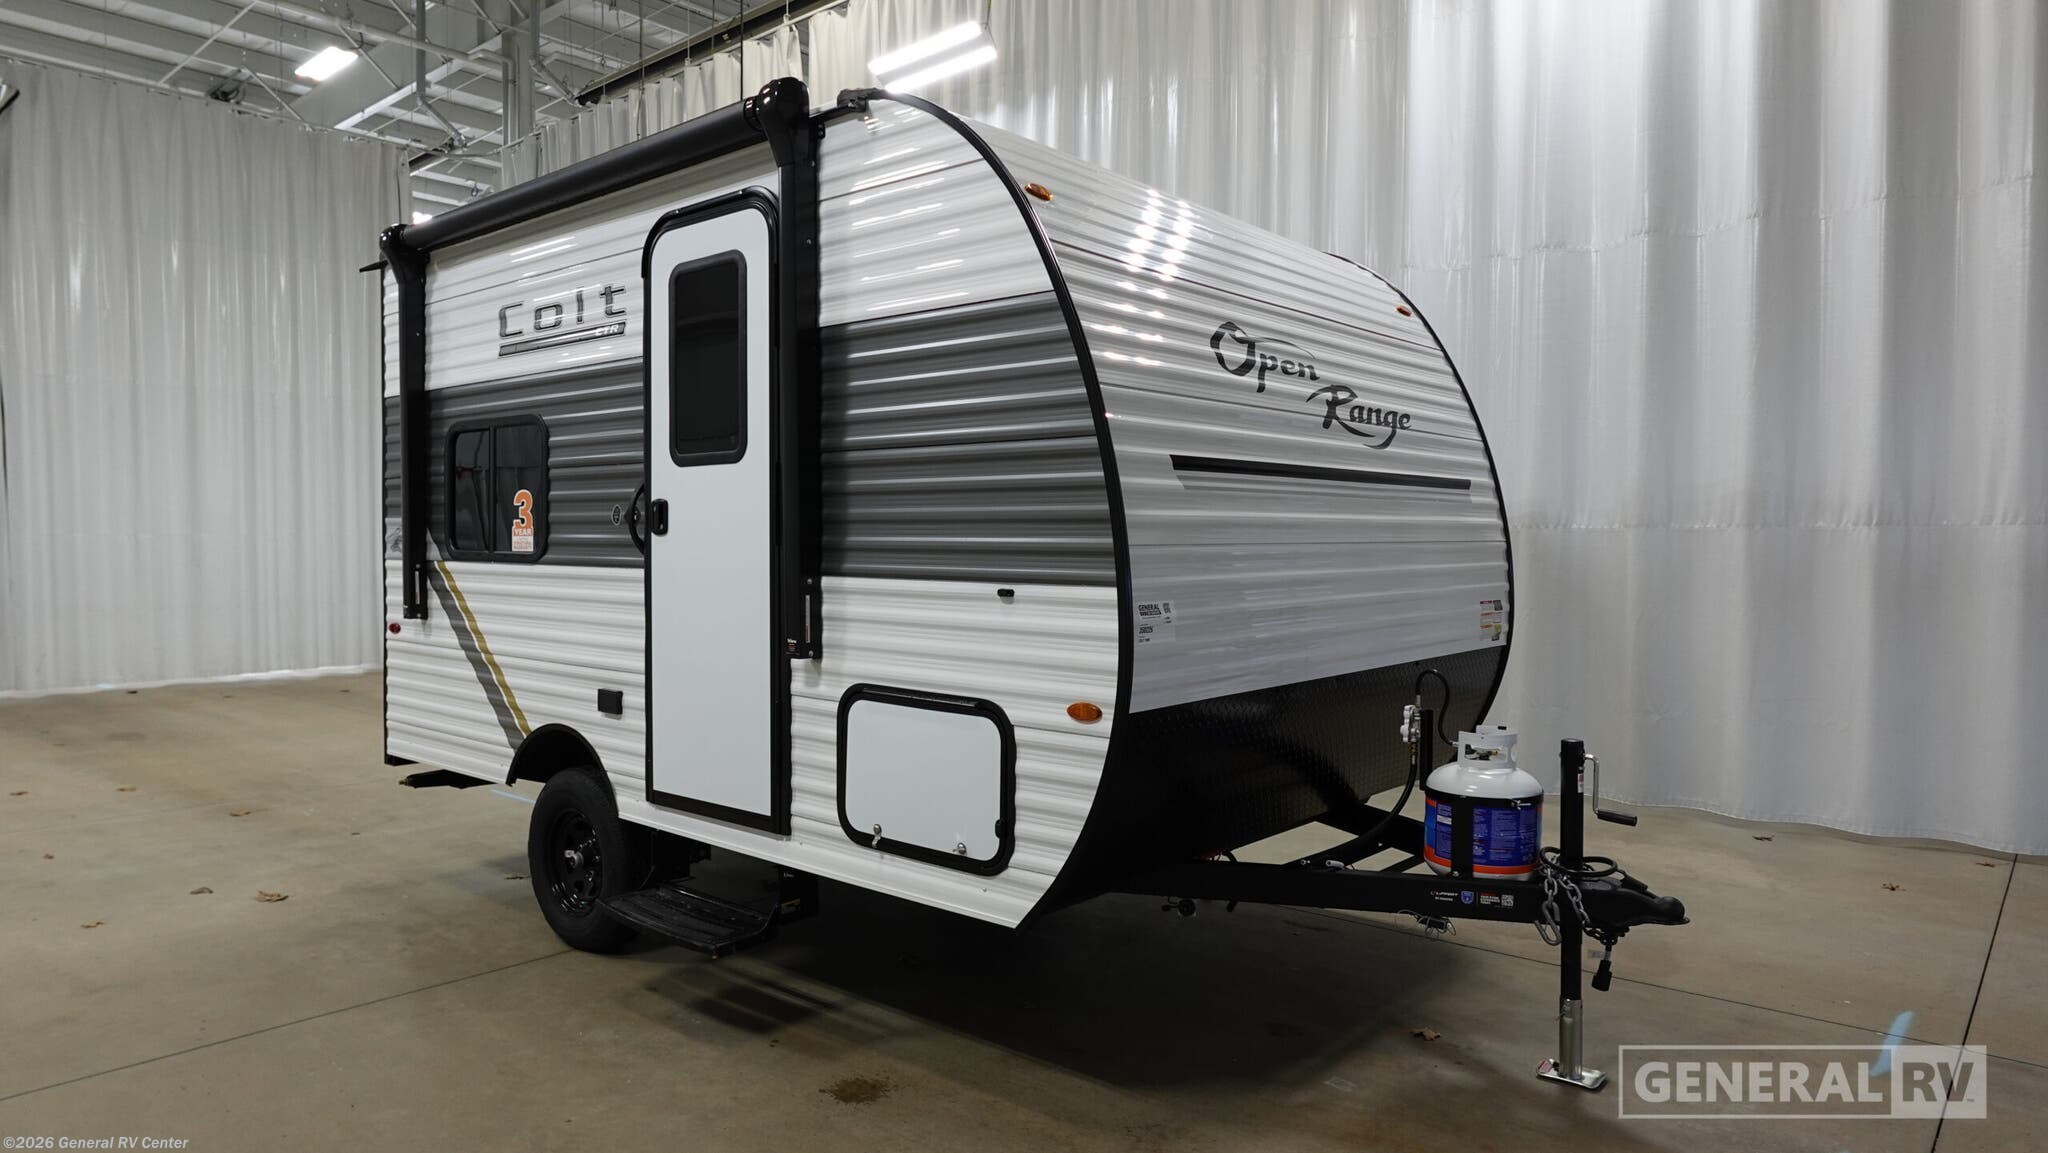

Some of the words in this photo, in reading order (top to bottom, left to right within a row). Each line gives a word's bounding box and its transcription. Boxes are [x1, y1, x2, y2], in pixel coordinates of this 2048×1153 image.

[499, 285, 627, 338] Colt
[1210, 321, 1320, 393] Open
[1306, 384, 1412, 450] Range
[513, 489, 533, 528] 3
